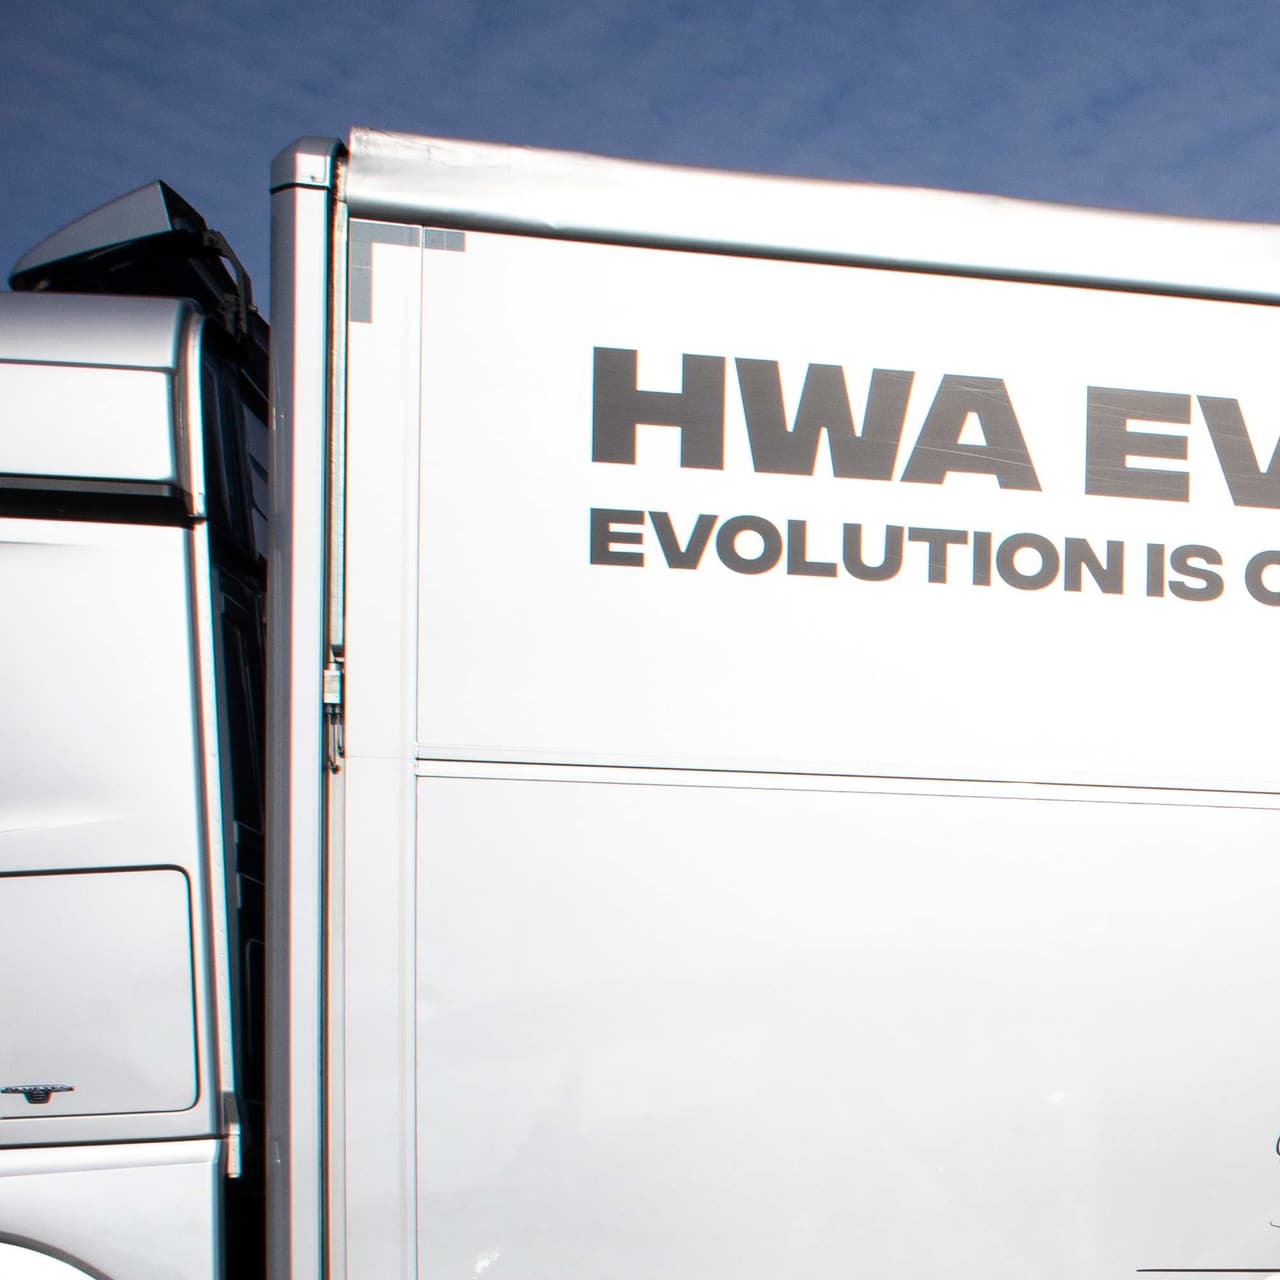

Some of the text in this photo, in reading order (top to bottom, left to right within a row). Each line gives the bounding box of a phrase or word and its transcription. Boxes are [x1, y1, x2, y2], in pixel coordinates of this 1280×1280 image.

[590, 346, 1042, 493] HWA
[589, 507, 1127, 594] EVOLUTION
[1145, 542, 1225, 603] IS
